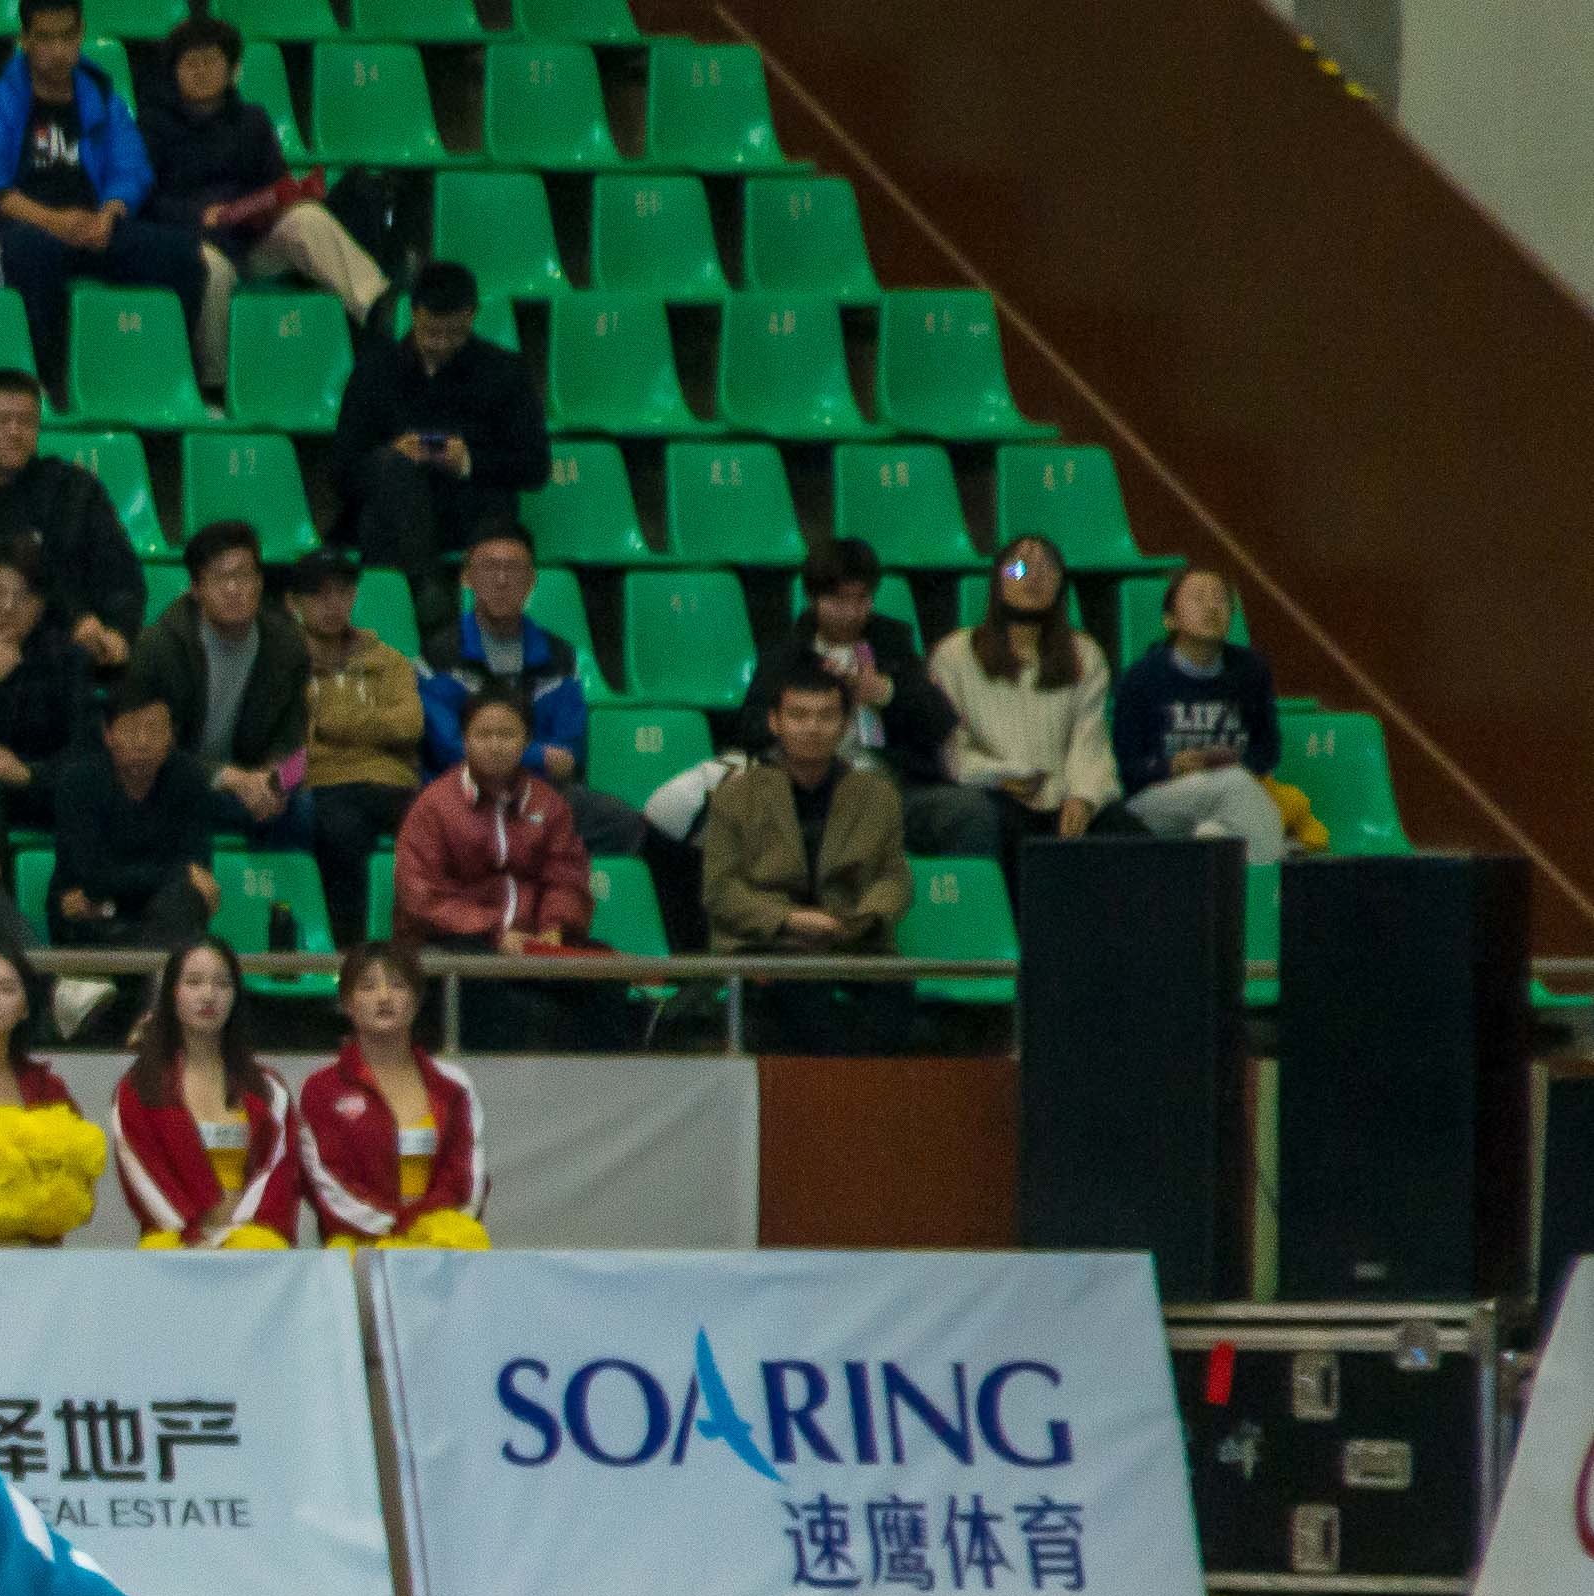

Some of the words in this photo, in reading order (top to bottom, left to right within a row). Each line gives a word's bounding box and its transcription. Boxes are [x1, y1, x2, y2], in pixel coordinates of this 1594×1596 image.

[497, 1326, 1074, 1484] SOARING
[112, 1498, 253, 1528] ESTATE
[782, 1494, 1086, 1592] 速鹰体育
